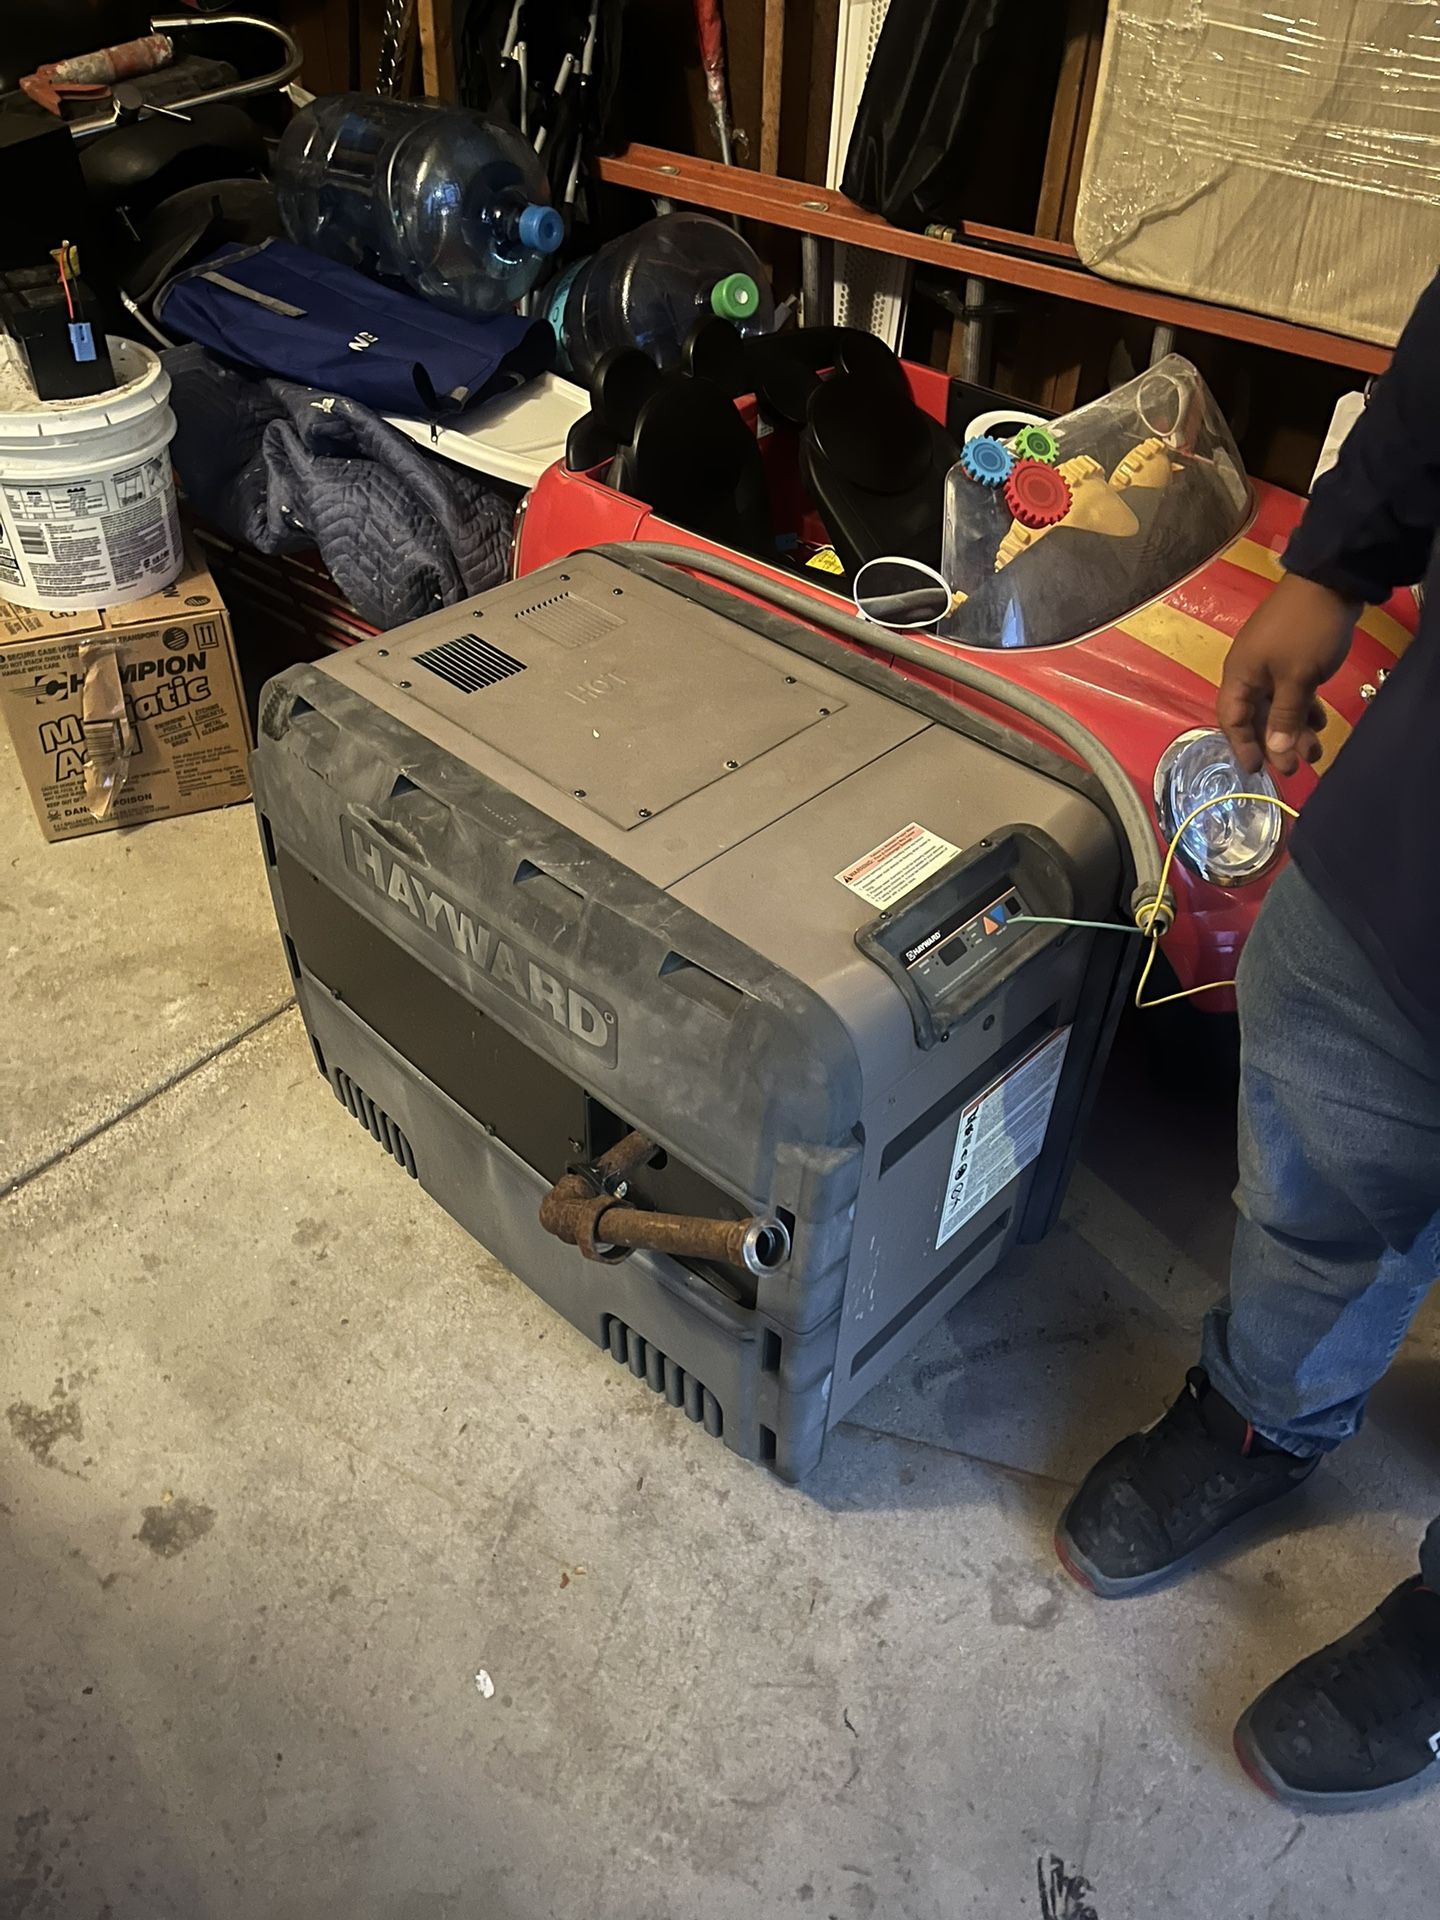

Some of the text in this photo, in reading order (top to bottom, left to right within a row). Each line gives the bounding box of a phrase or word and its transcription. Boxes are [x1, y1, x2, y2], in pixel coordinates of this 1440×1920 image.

[118, 630, 160, 643] TRANSPORT
[35, 651, 207, 704] CHMPION
[39, 675, 212, 753] Miatic
[64, 806, 91, 817] DAN
[112, 793, 153, 808] POISON
[351, 829, 609, 1048] HAYWARD
[913, 930, 941, 956] HAYWARD
